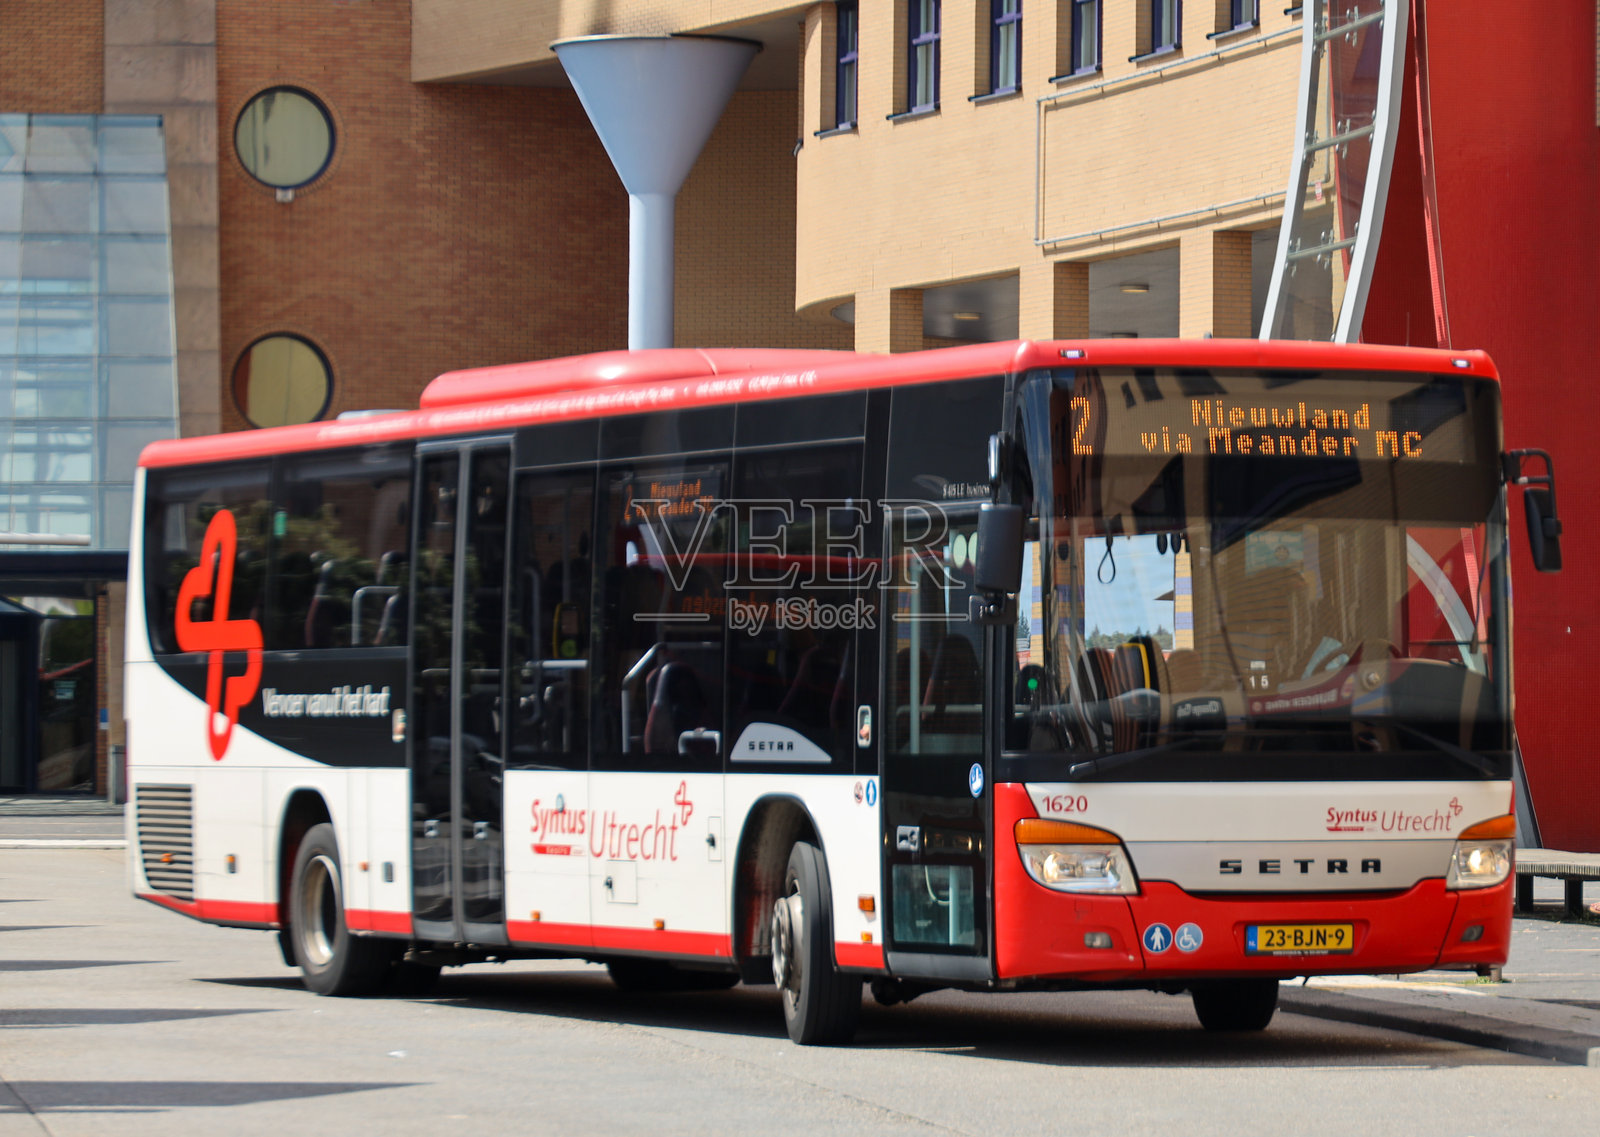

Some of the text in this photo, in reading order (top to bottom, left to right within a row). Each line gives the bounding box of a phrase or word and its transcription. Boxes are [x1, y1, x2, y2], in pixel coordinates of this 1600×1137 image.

[1070, 397, 1092, 455] 2
[1192, 400, 1370, 430] Nieuwland
[1141, 426, 1422, 457] via Meander MC
[748, 741, 794, 751] SETRA
[1042, 795, 1088, 812] 1620
[531, 799, 678, 861] Syntus Utrecht
[1326, 807, 1451, 832] Syntus Utrecht
[1219, 859, 1381, 874] SETRA
[1265, 929, 1345, 947] 23-BJN-9
